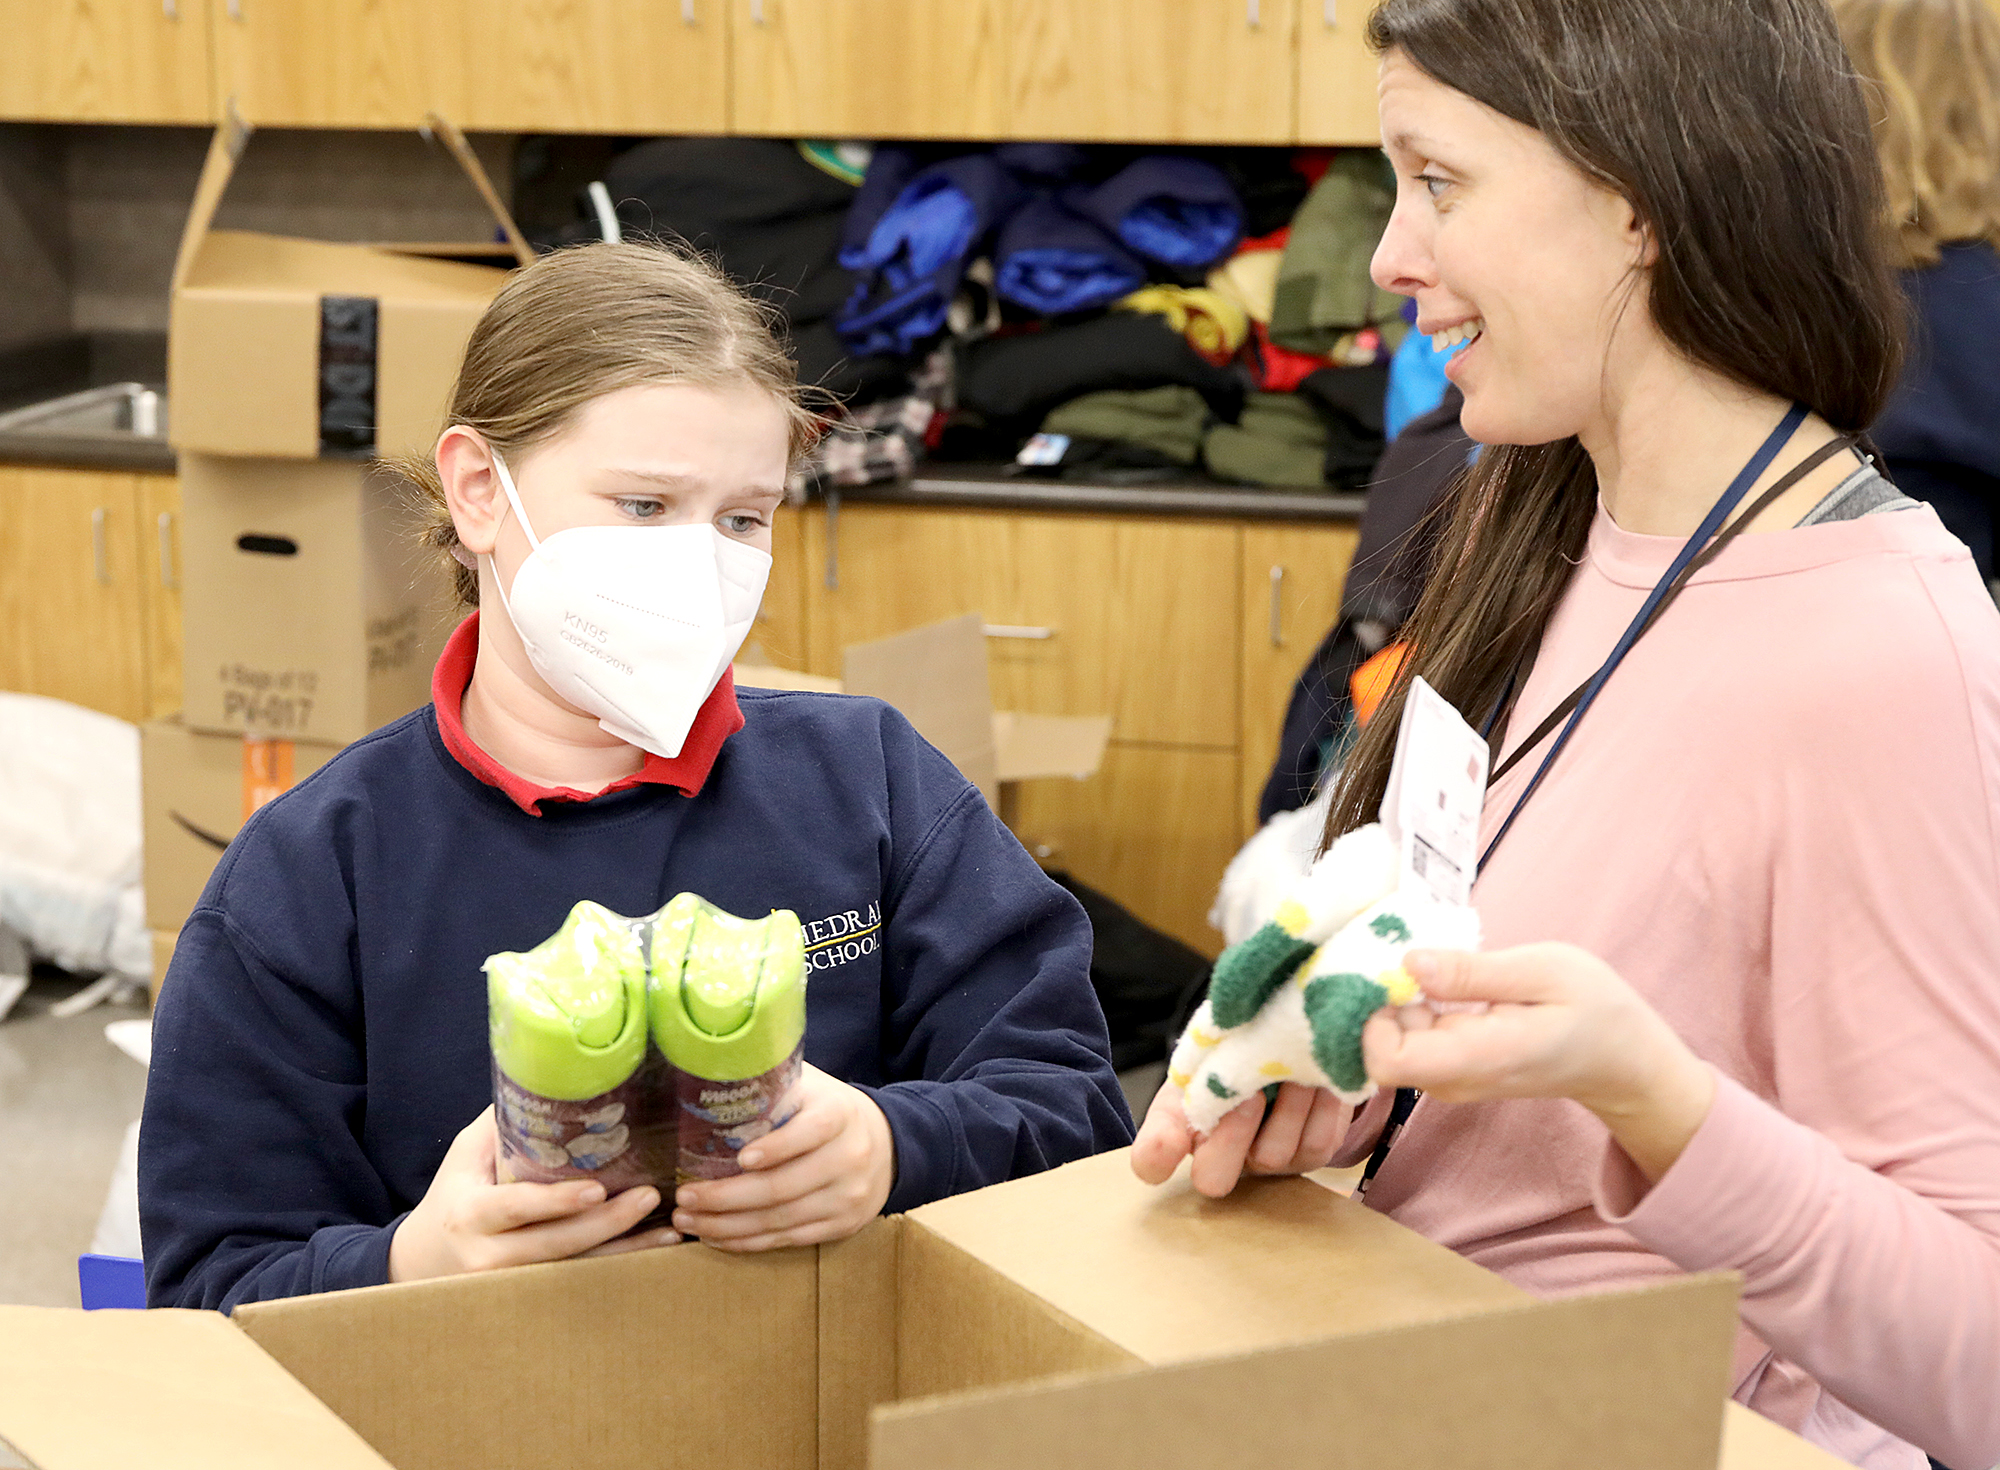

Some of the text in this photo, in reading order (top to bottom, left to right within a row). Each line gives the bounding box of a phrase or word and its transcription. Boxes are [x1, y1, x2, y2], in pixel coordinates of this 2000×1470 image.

[564, 611, 608, 644] KN95
[801, 900, 881, 945] HEDRAL
[802, 933, 880, 975] SCHOOL
